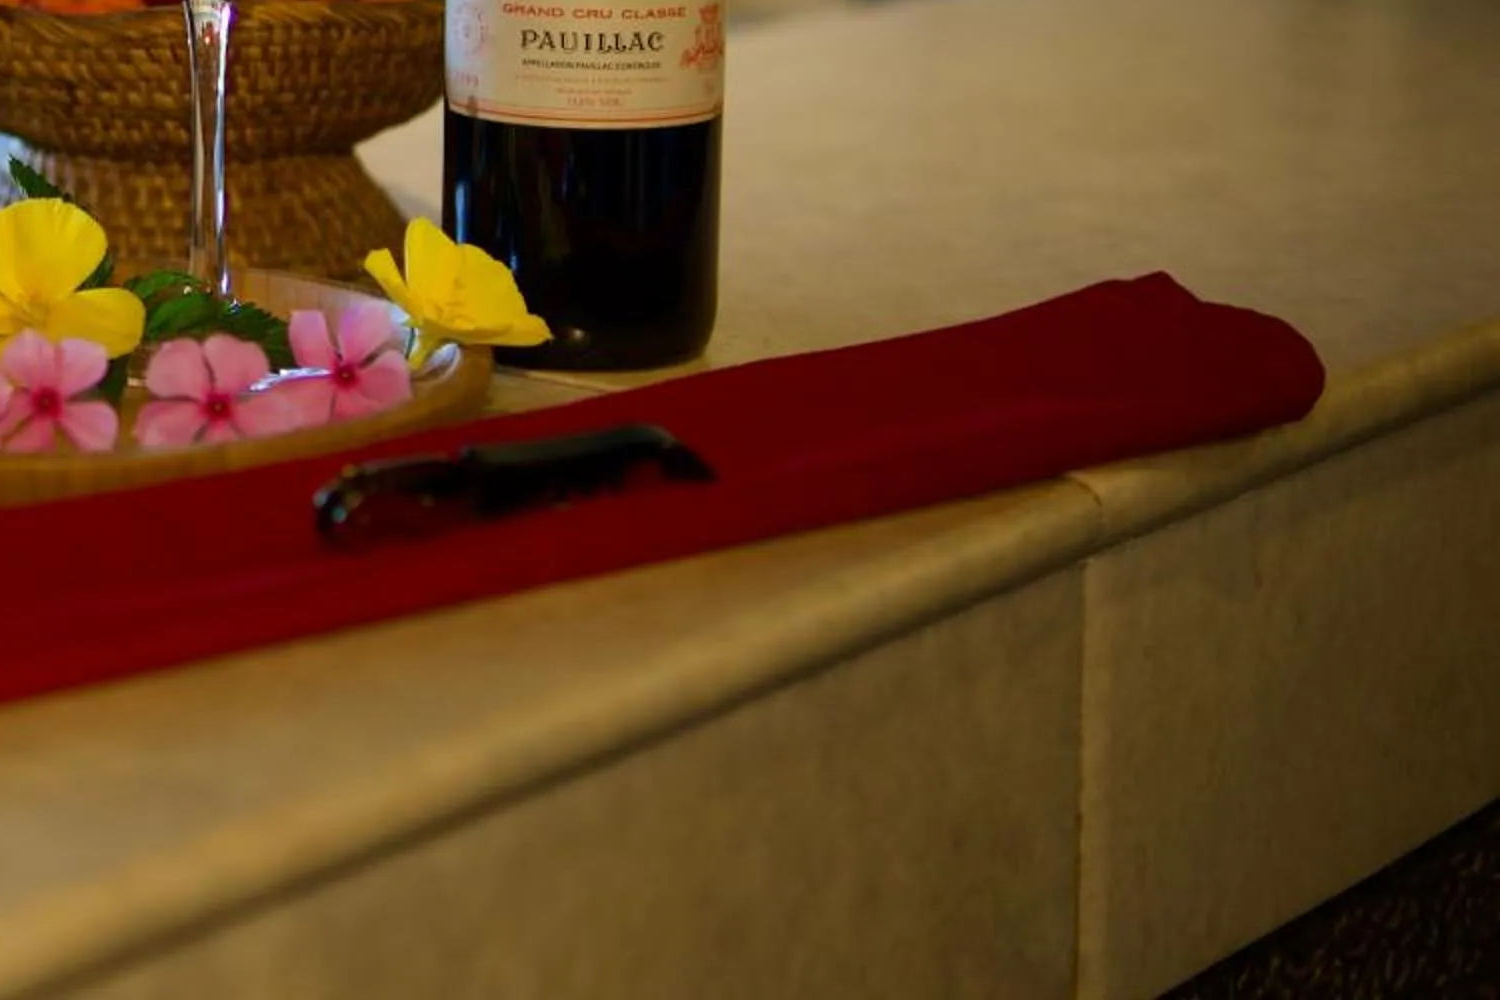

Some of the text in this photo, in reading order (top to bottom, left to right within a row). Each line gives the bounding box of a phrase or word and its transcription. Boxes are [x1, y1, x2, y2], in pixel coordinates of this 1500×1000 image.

[502, 2, 565, 18] GRAND
[571, 6, 613, 19] CRU
[520, 28, 666, 52] PAUILLAC
